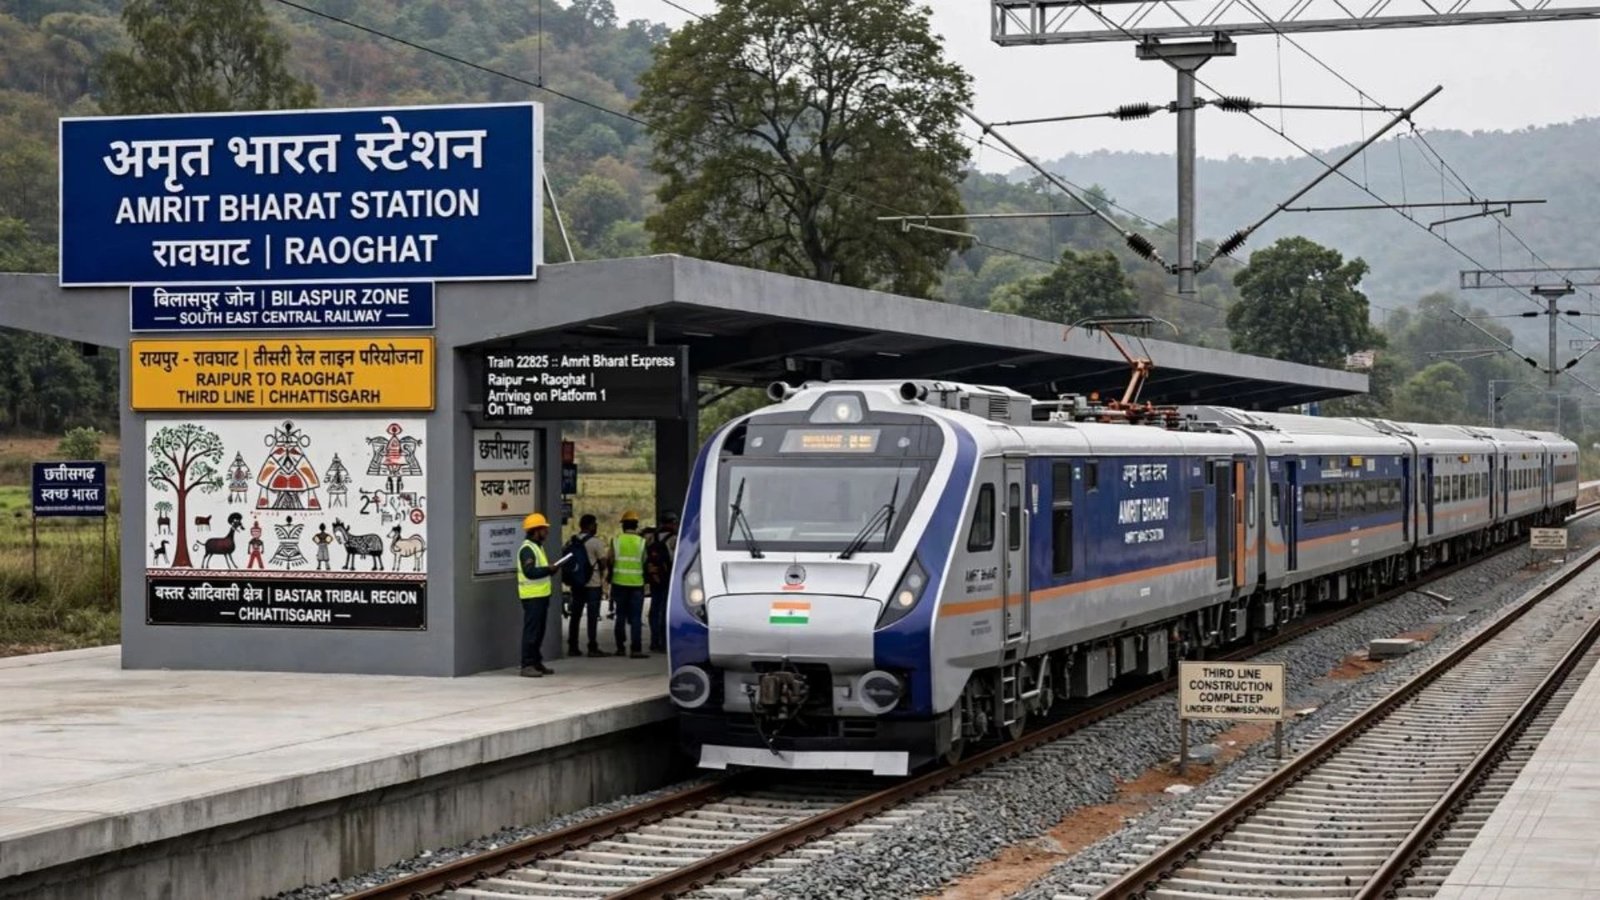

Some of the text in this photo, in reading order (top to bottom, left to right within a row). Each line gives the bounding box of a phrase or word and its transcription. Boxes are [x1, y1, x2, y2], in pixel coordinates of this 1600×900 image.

[103, 116, 487, 192] अमृत भारत स्टेशन
[116, 189, 478, 224] AMRIT BHARAT STATION
[152, 239, 250, 267] रावघाट
[286, 235, 438, 264] RAOGHAT
[153, 286, 255, 312] बिलासपुर जोन
[272, 289, 409, 305] BILASPUR ZONE
[180, 310, 382, 324] SOUTH EAST CENTRAL RAILWAY
[140, 352, 178, 372] रायपुर
[193, 352, 239, 366] रावघाट
[254, 345, 292, 366] तीसरी
[296, 345, 316, 365] रेल
[319, 350, 355, 367] लाइन
[359, 343, 424, 365] परियोजना
[488, 356, 514, 368] Train
[517, 355, 548, 368] 22825
[561, 355, 590, 367] Amrit
[593, 355, 628, 367] Bharat
[631, 354, 675, 369] Express
[197, 372, 354, 386] RAIPUR TO RAOGHAT
[488, 373, 585, 390] Raipur Raoghat
[177, 390, 380, 403] THIRD LINE CHHATTISGARH
[488, 388, 605, 405] Arriving on Platform 1
[488, 402, 533, 415] On Time
[43, 464, 96, 483] छत्तीसगढ़
[41, 489, 99, 502] स्वच्छ भारत
[155, 583, 263, 602] बस्तर आदिवासी क्षेत्र
[275, 589, 416, 604] BASTAR TRIBAL REGION
[239, 607, 330, 622] CHHATTISGARH
[1203, 668, 1260, 679] THIRD LINE
[1189, 680, 1272, 691] CONSTRUCTION
